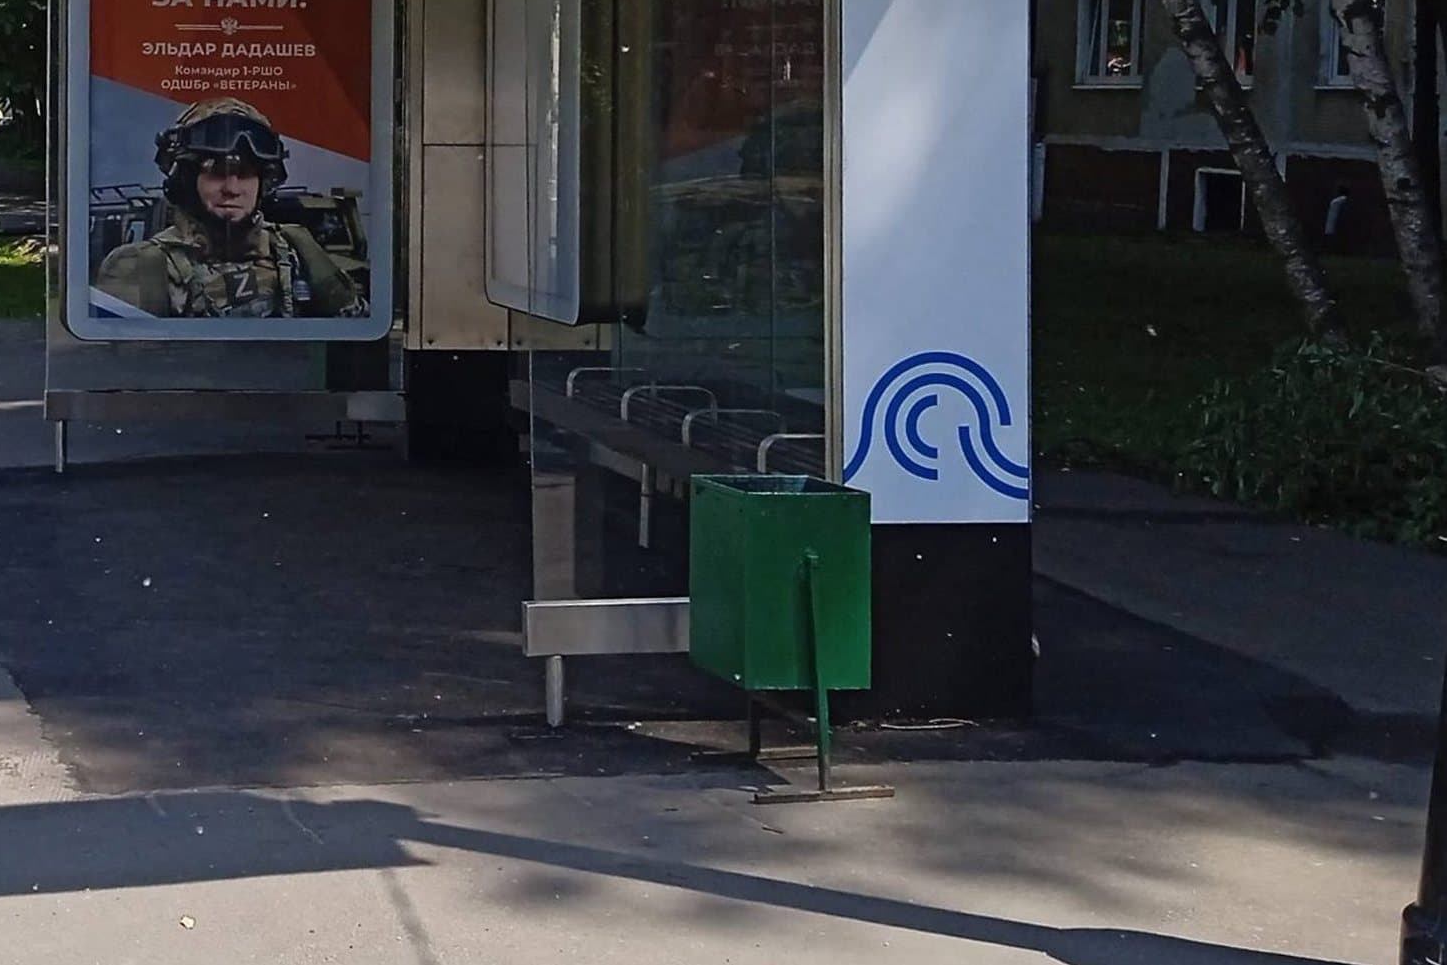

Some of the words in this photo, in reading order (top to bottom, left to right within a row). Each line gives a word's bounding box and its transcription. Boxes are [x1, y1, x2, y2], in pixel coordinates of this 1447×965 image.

[142, 42, 217, 59] ЭЛЬДАР
[221, 43, 317, 59] ДАДАШЕВ
[174, 65, 240, 77] Командир
[233, 272, 254, 298] Z
